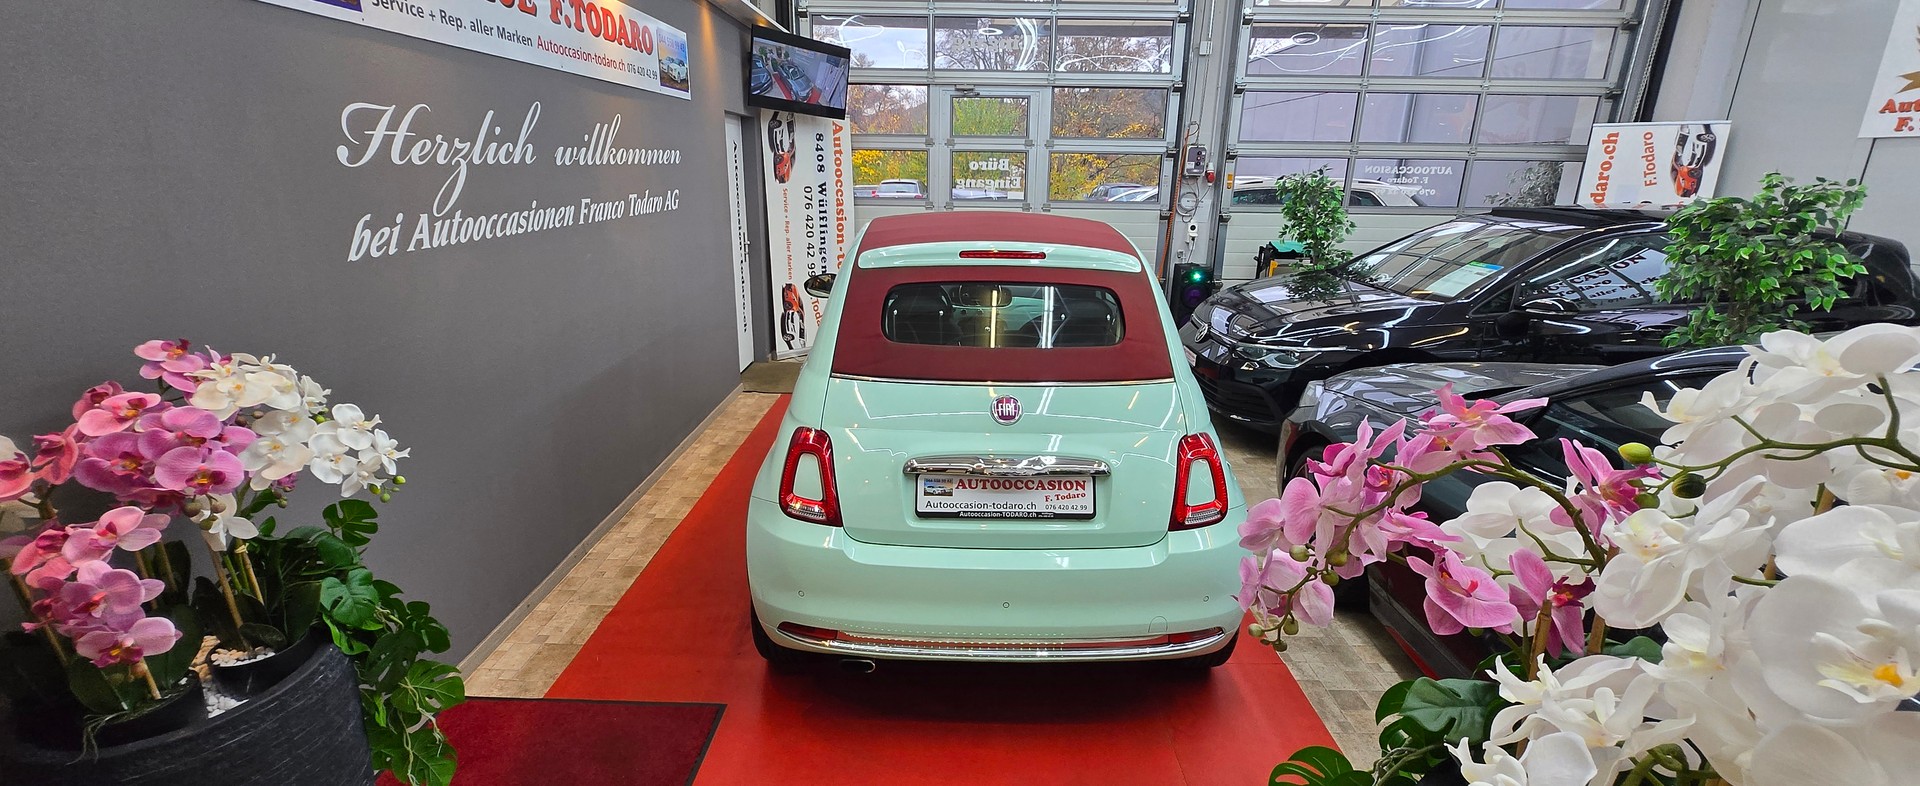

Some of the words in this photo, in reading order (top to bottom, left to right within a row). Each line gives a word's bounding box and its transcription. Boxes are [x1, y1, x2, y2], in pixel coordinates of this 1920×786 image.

[439, 9, 467, 31] Rep.
[470, 18, 494, 37] aller
[496, 25, 533, 47] Marken
[537, 35, 626, 72] Autooccasion-todaro.ch
[627, 62, 636, 75] 076
[637, 65, 645, 77] 420
[645, 69, 652, 79] 42
[652, 70, 658, 81] 99
[336, 100, 542, 217] Herzlich
[554, 113, 682, 166] willkommen
[815, 132, 826, 174] 8408
[1640, 131, 1658, 187] F.Todaro
[803, 186, 814, 210] 076
[347, 212, 404, 263] bei
[406, 199, 575, 252] Autooccasionen
[578, 198, 625, 226] Franco
[628, 189, 664, 217] Todaro
[663, 189, 681, 212] AG
[805, 214, 815, 239] 420
[806, 242, 816, 259] 42
[807, 262, 817, 279] 99
[998, 402, 1016, 416] FIAT
[955, 478, 1087, 491] AUTOOCCASION
[925, 500, 1037, 510] Autooccasion-todaro.ch
[1044, 495, 1054, 503] F.
[1054, 492, 1087, 502] Todaro
